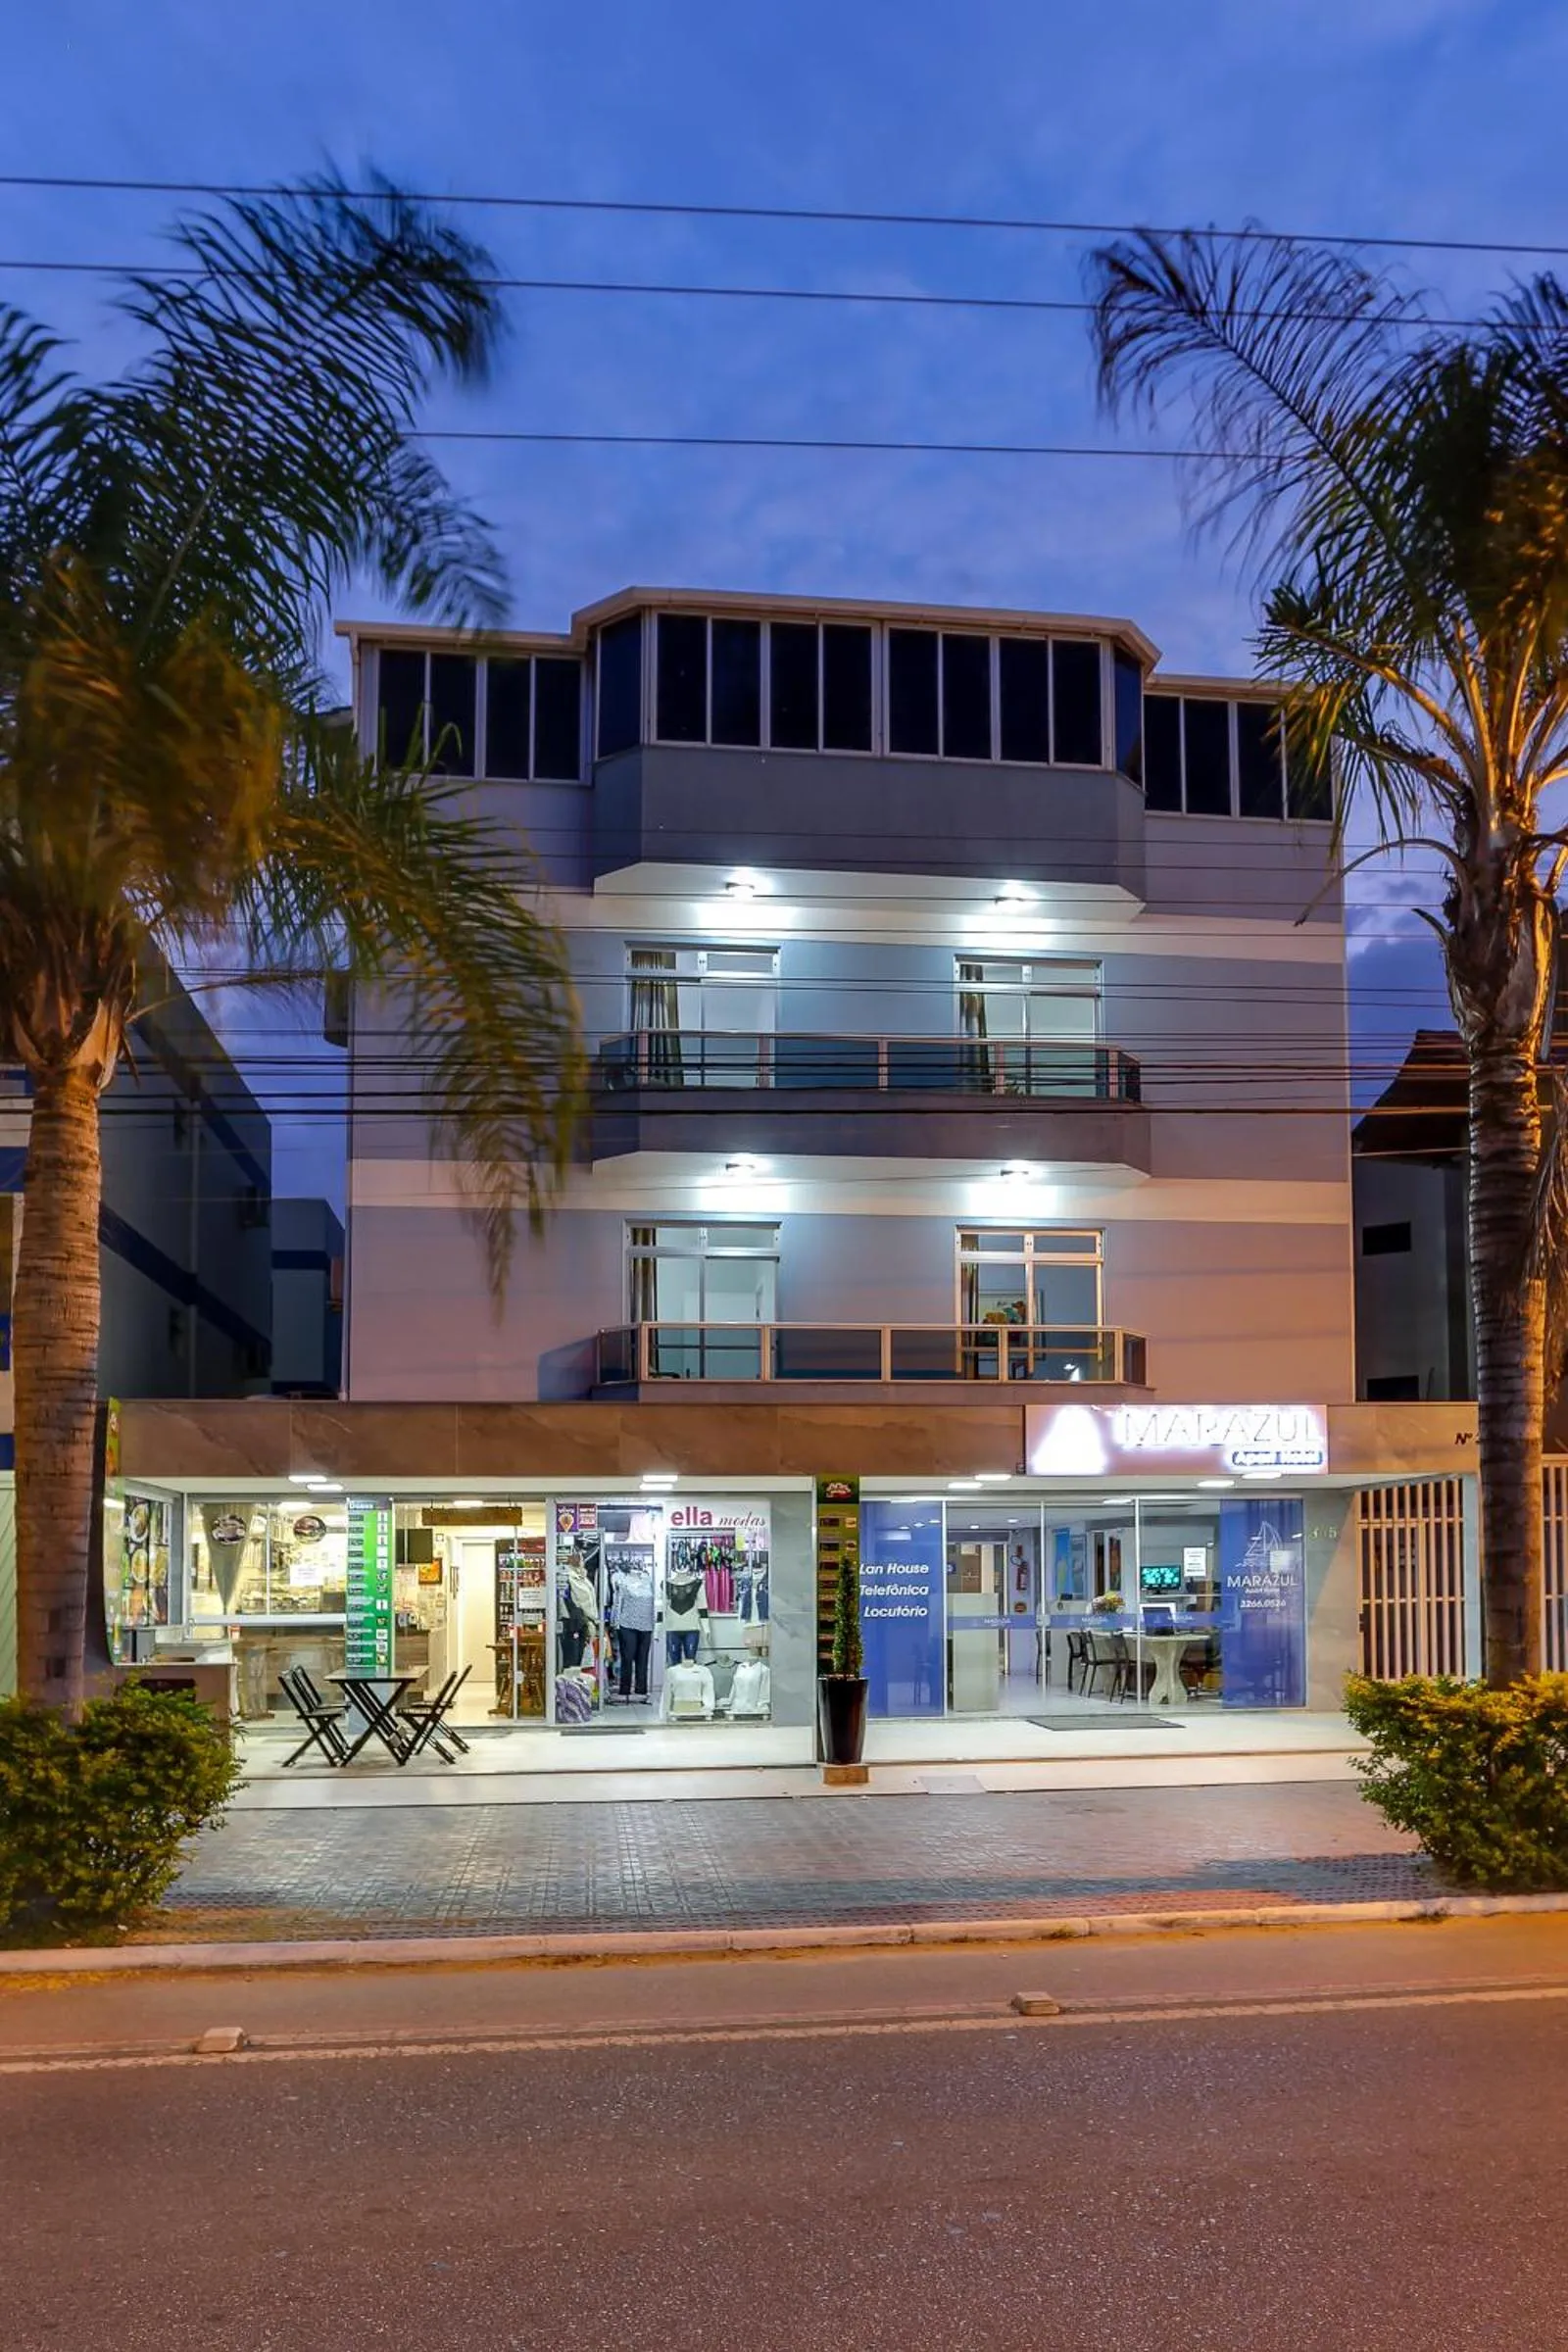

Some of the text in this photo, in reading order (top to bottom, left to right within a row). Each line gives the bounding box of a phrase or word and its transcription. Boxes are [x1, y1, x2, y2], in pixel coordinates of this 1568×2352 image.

[1122, 1412, 1321, 1445] MARAZUL
[670, 1506, 766, 1527] ella modas
[859, 1563, 930, 1575] Lan House
[1227, 1575, 1298, 1588] MARAZUL
[859, 1583, 929, 1595] Telefônica
[863, 1605, 928, 1617] Locutório
